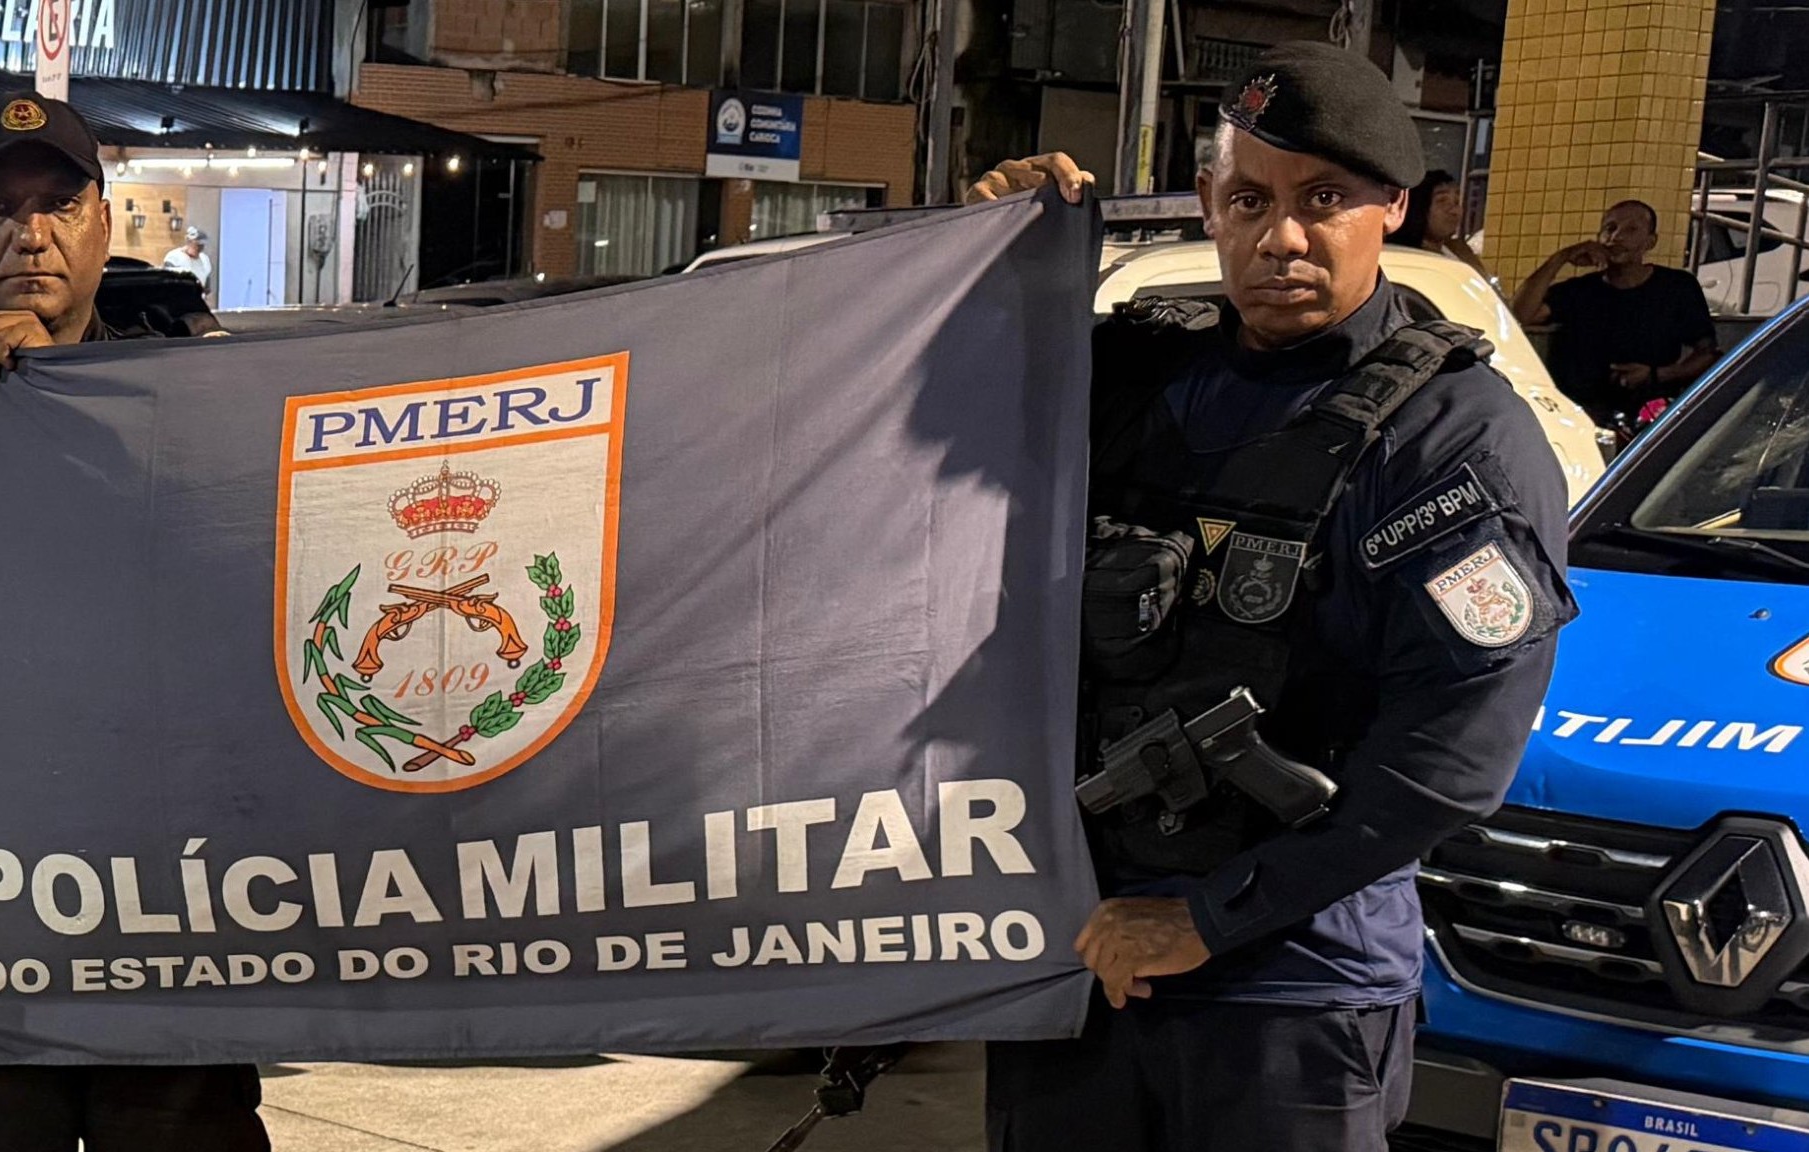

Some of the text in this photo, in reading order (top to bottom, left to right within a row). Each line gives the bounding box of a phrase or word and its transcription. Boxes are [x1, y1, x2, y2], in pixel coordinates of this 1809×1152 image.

[305, 376, 602, 453] PMERJ
[1437, 480, 1481, 518] BPM
[1233, 535, 1301, 557] PMERJ
[1434, 550, 1494, 592] PMERJ
[392, 661, 490, 700] 1809
[455, 777, 1037, 919] MILITAR
[68, 948, 315, 990] ESTADO
[338, 945, 431, 982] DO
[452, 939, 571, 978] RIO
[594, 931, 687, 971] DE
[711, 908, 1046, 967] JANEIRO
[1644, 1115, 1699, 1138] BRASIL
